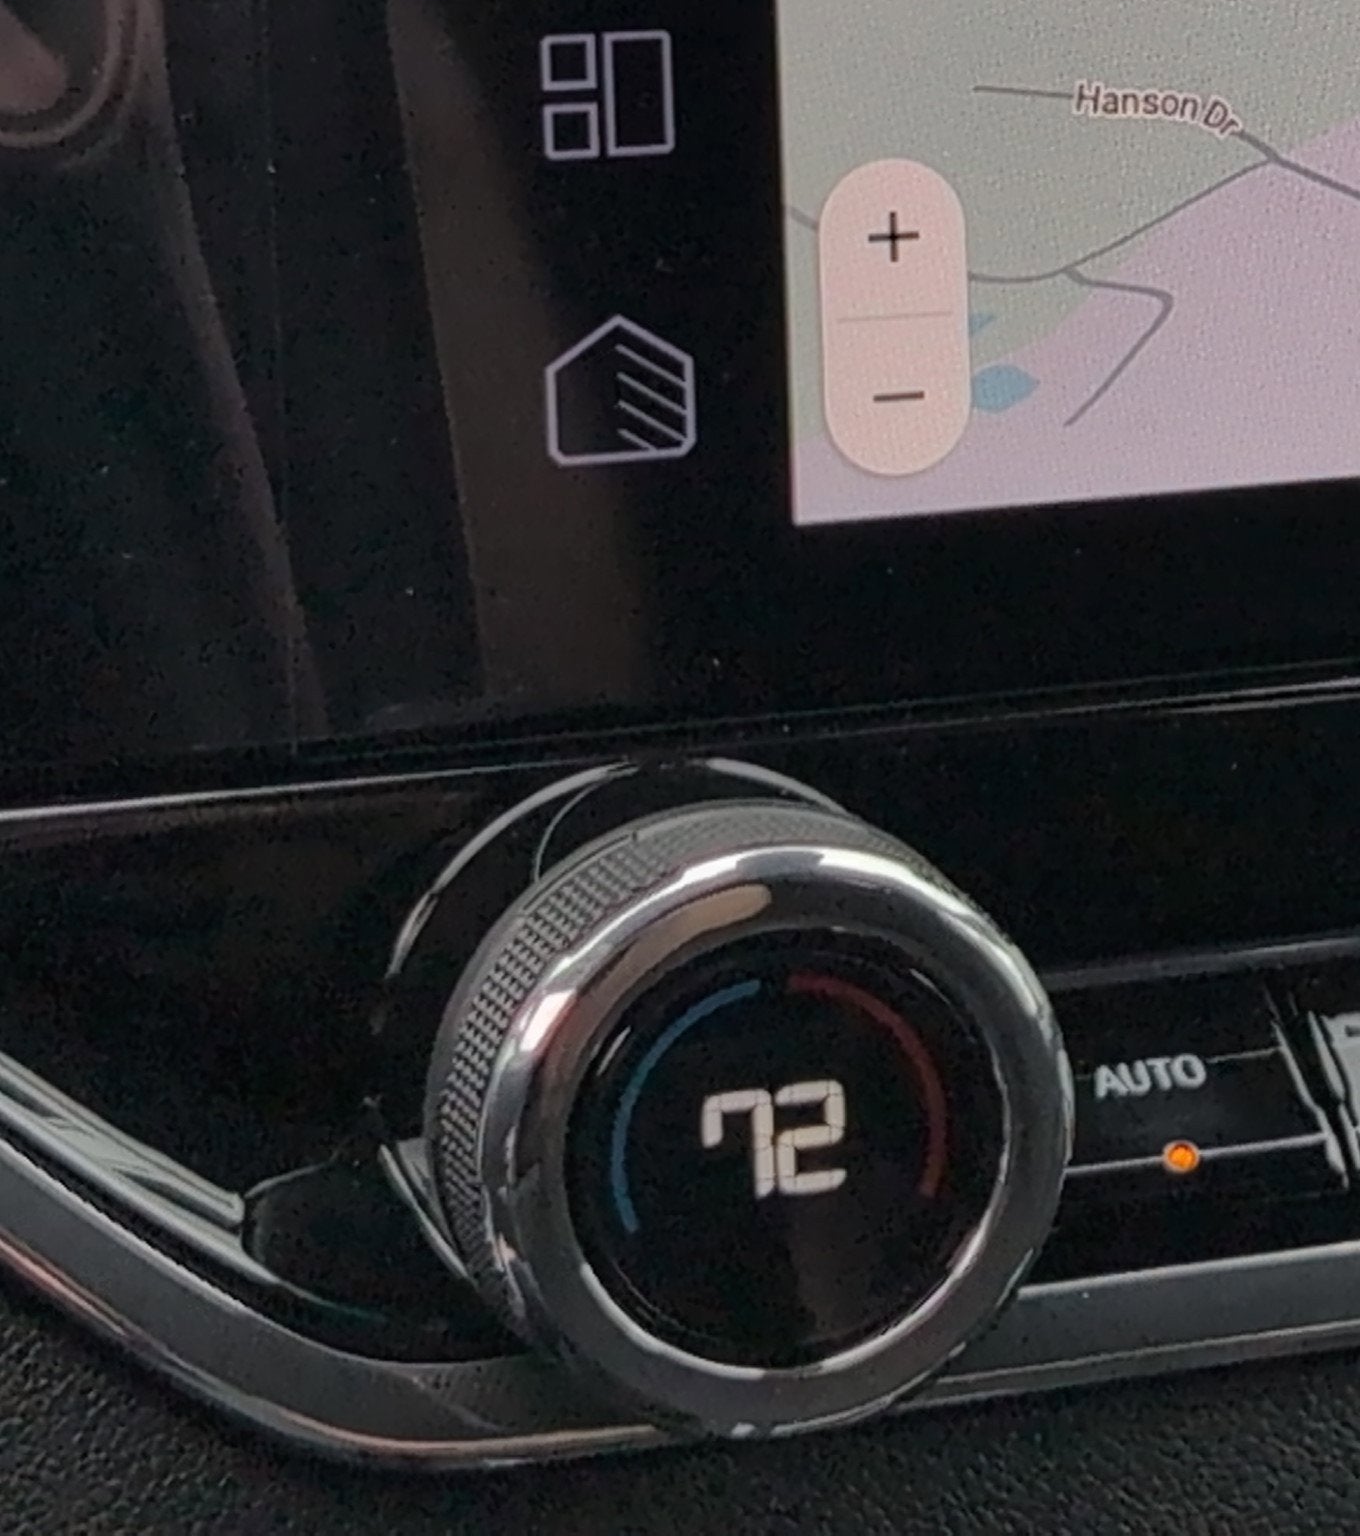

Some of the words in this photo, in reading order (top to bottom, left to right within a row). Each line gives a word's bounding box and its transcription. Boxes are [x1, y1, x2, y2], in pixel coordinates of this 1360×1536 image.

[1074, 83, 1200, 122] Hanson
[1202, 96, 1240, 137] Dr
[1093, 1053, 1207, 1099] AUTO
[702, 1078, 847, 1200] 72
